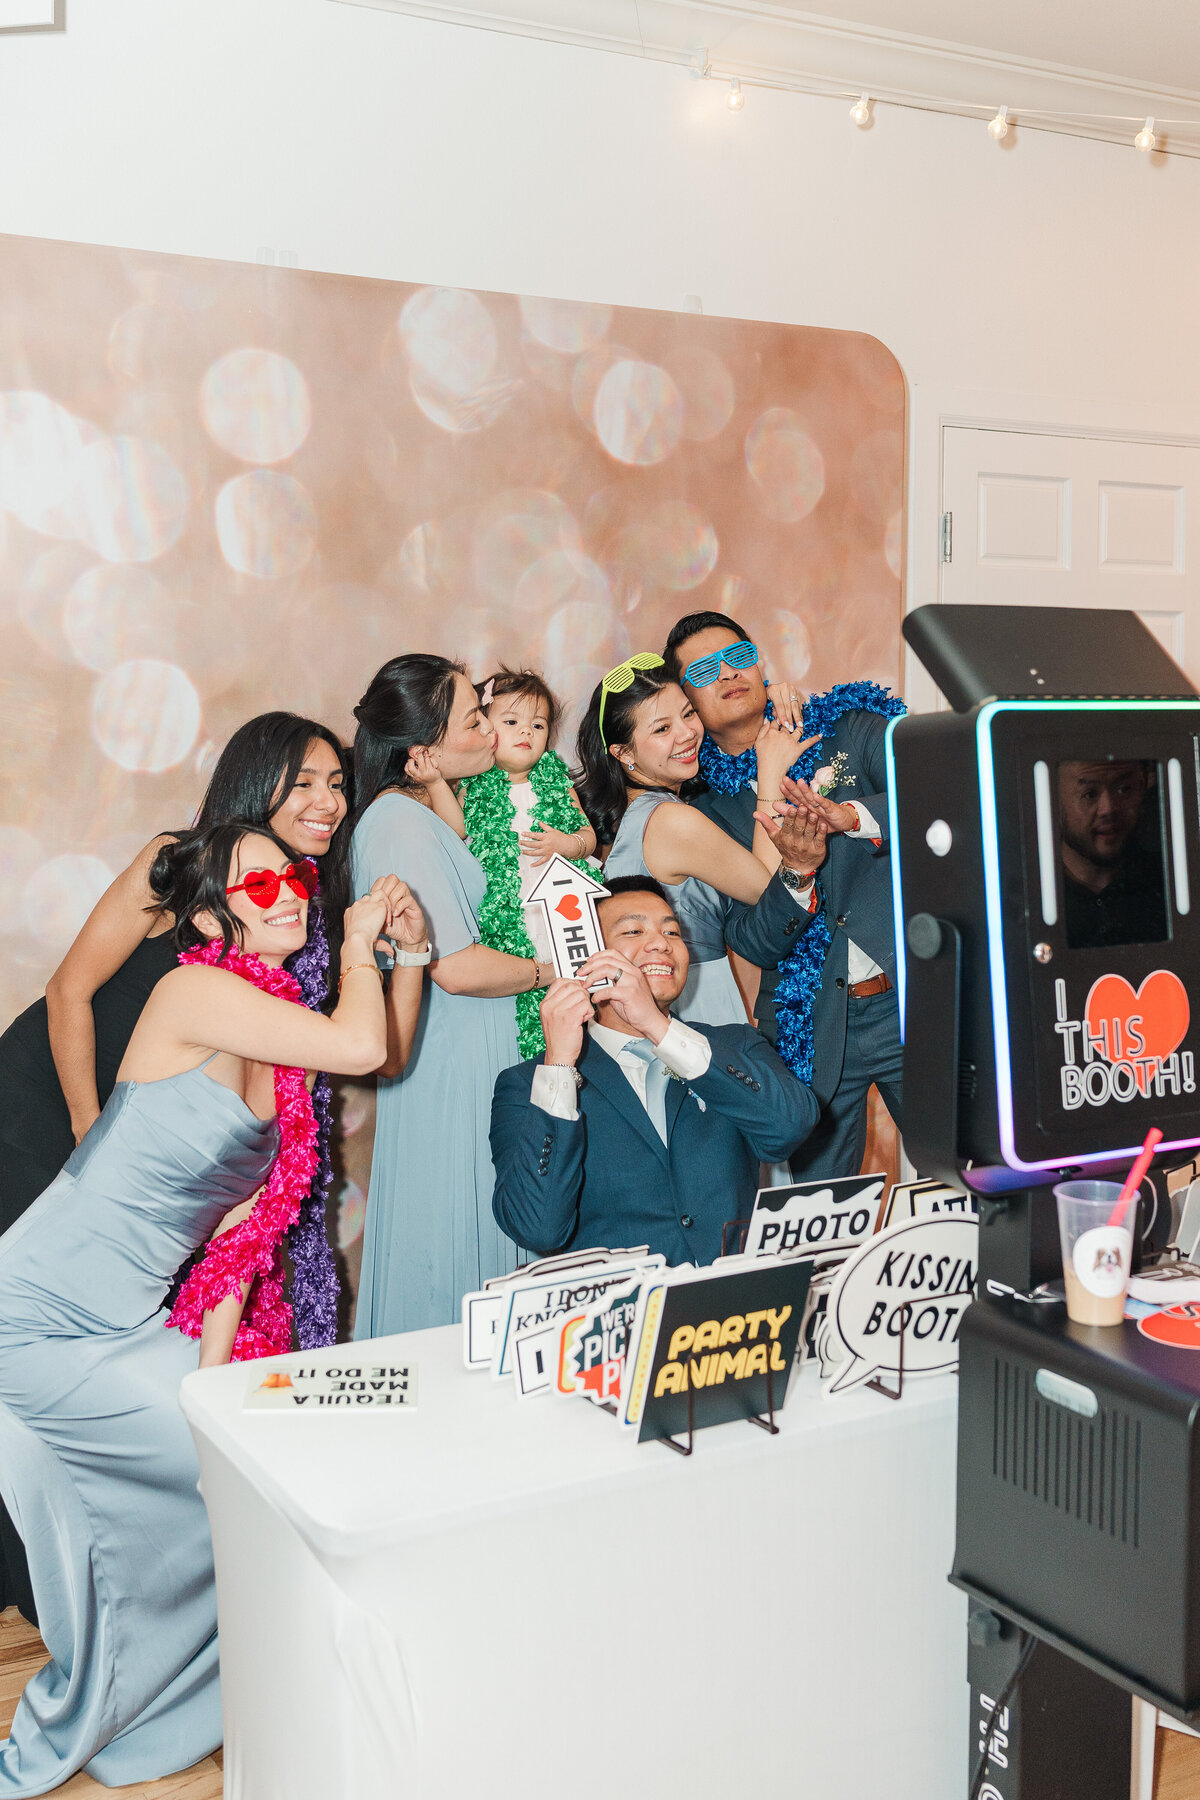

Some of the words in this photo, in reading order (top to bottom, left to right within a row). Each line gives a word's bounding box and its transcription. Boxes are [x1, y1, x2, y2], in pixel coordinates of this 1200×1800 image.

[1054, 978, 1068, 1022] I
[1054, 1014, 1147, 1066] THIS
[1060, 1050, 1197, 1111] BOOTH!
[758, 1208, 870, 1250] PHOTO
[876, 1250, 977, 1294] KISSIN
[600, 1302, 637, 1332] WE'R
[667, 1305, 793, 1361] PARTY
[862, 1301, 959, 1343] BOOT
[294, 1368, 316, 1378] IT
[325, 1367, 362, 1378] DO
[331, 1380, 409, 1392] MADE
[371, 1367, 409, 1378] ME
[653, 1341, 787, 1399] ANIMAL
[292, 1394, 409, 1405] TEQUILA
